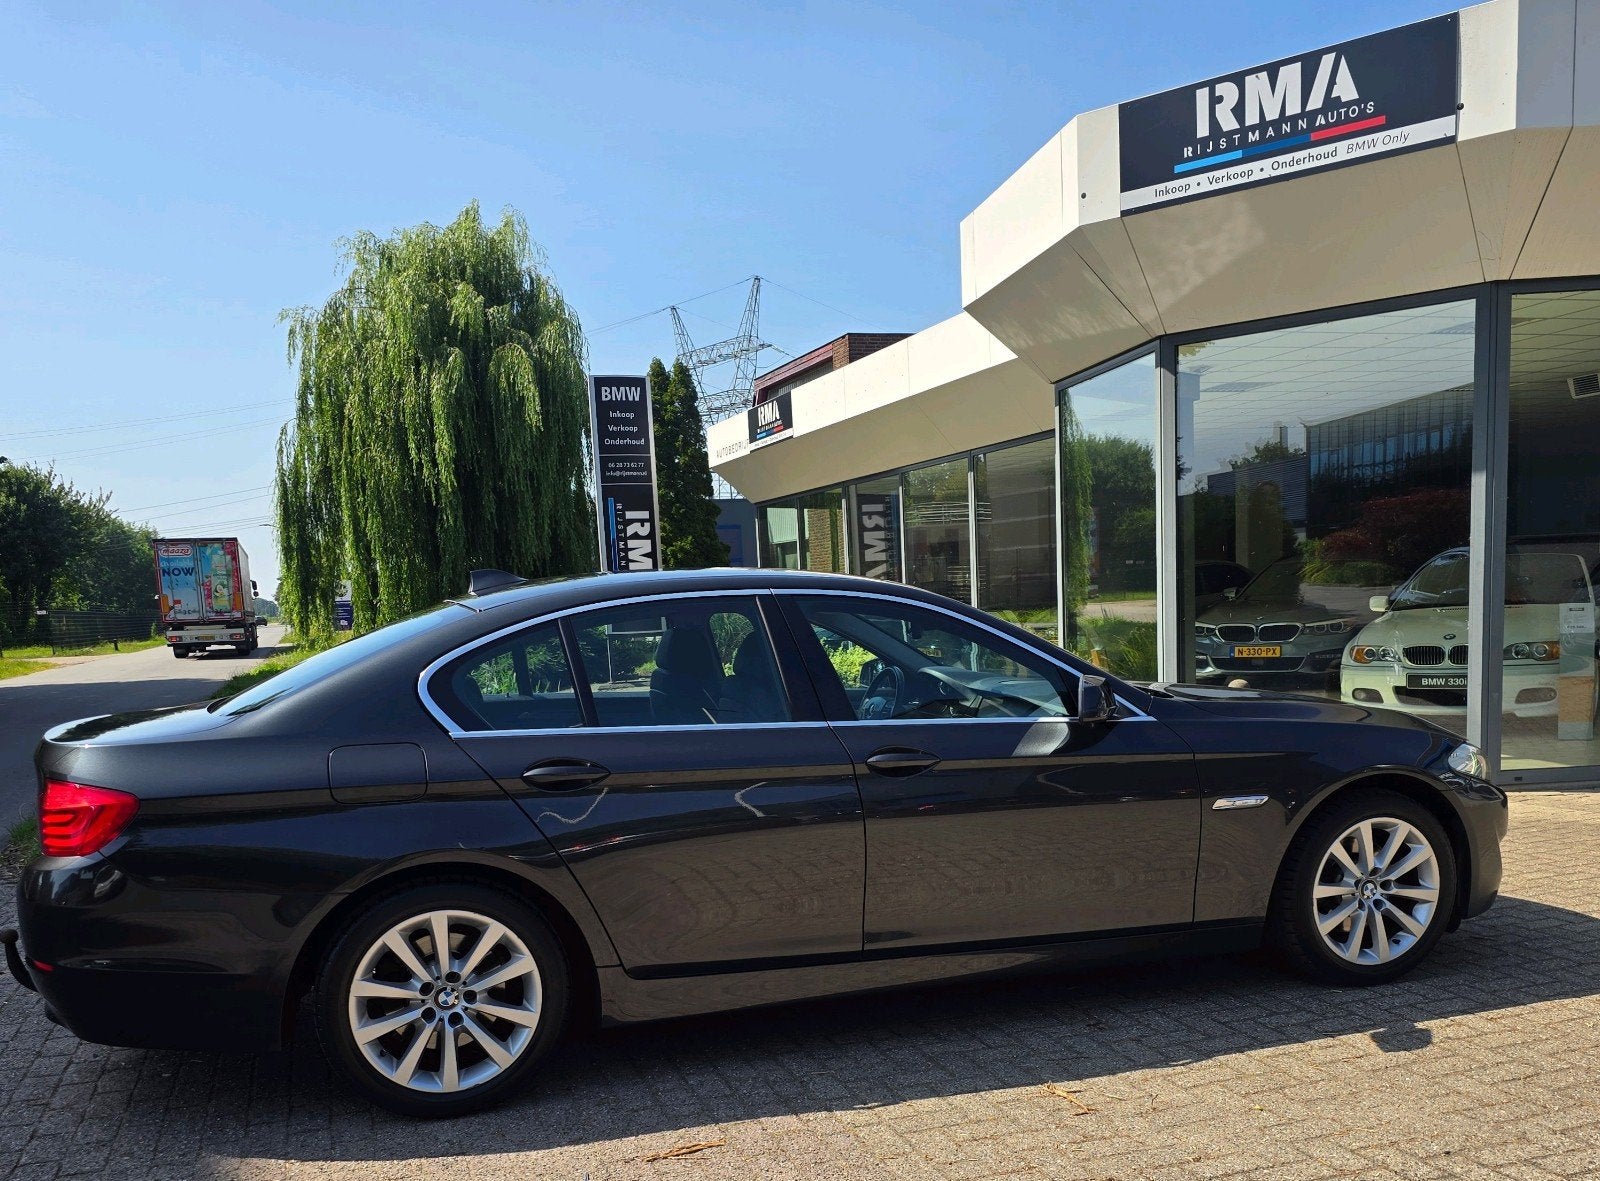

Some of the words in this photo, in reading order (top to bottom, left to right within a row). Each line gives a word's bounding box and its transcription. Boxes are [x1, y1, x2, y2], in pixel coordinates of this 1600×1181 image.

[1195, 52, 1360, 139] RMA
[1183, 117, 1308, 159] RIJSTMANN
[1315, 101, 1375, 127] AUTO'S
[1154, 181, 1191, 198] Inkoop
[1207, 167, 1254, 186] Verkoop
[1271, 147, 1338, 172] Onderhoud
[1346, 137, 1379, 155] BMW
[1380, 130, 1411, 150] Only
[601, 386, 641, 402] BMW
[609, 410, 635, 420] Inkoop
[757, 400, 781, 427] RMA
[607, 424, 638, 433] Verkoop
[604, 437, 645, 445] Onderhoud
[616, 503, 627, 566] RIJSTMAN
[625, 510, 653, 570] RM
[162, 567, 195, 577] NOW
[1237, 647, 1278, 656] N-330-PX
[1421, 677, 1446, 686] BMW
